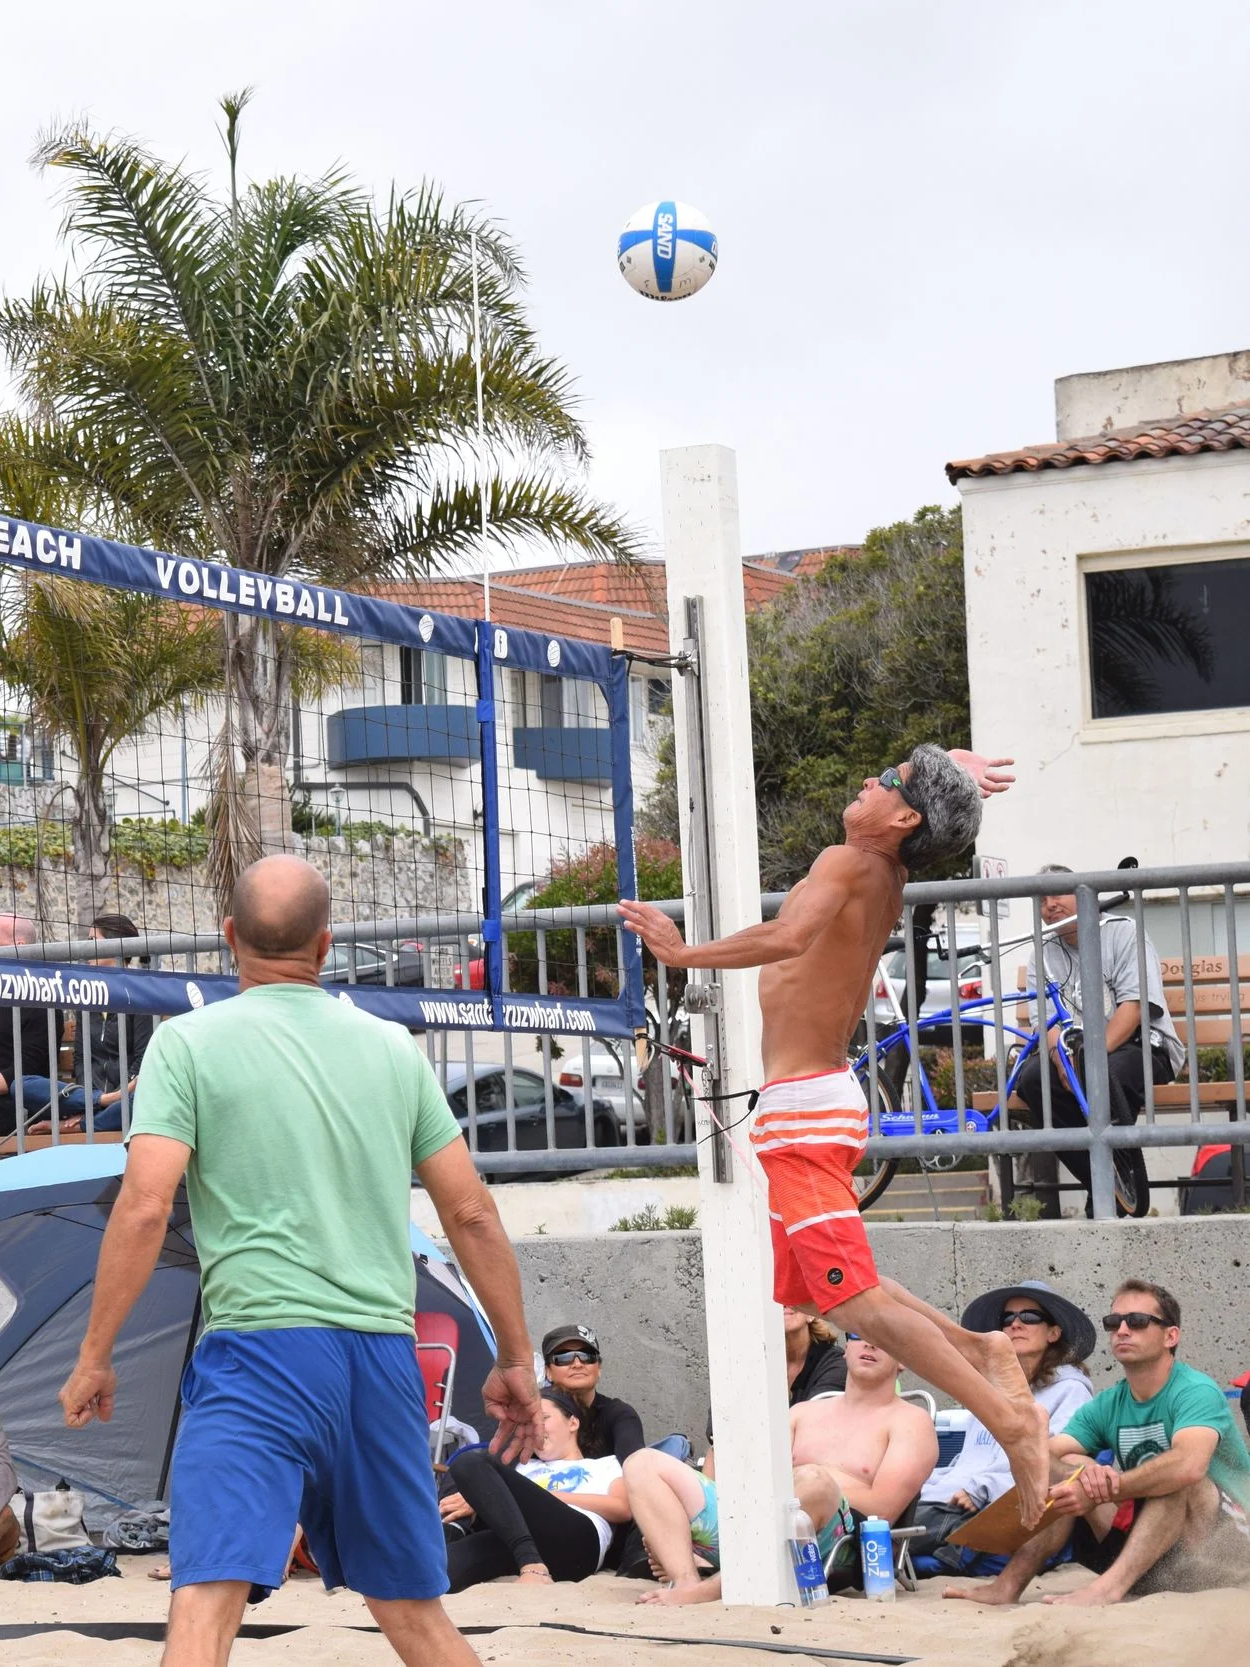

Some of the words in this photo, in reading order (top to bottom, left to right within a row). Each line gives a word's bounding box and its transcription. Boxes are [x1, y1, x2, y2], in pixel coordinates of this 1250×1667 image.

[657, 211, 674, 260] SAND
[156, 555, 350, 627] VOLLEYBALL
[1159, 960, 1223, 978] Doglas
[865, 1540, 881, 1577] ZICO
